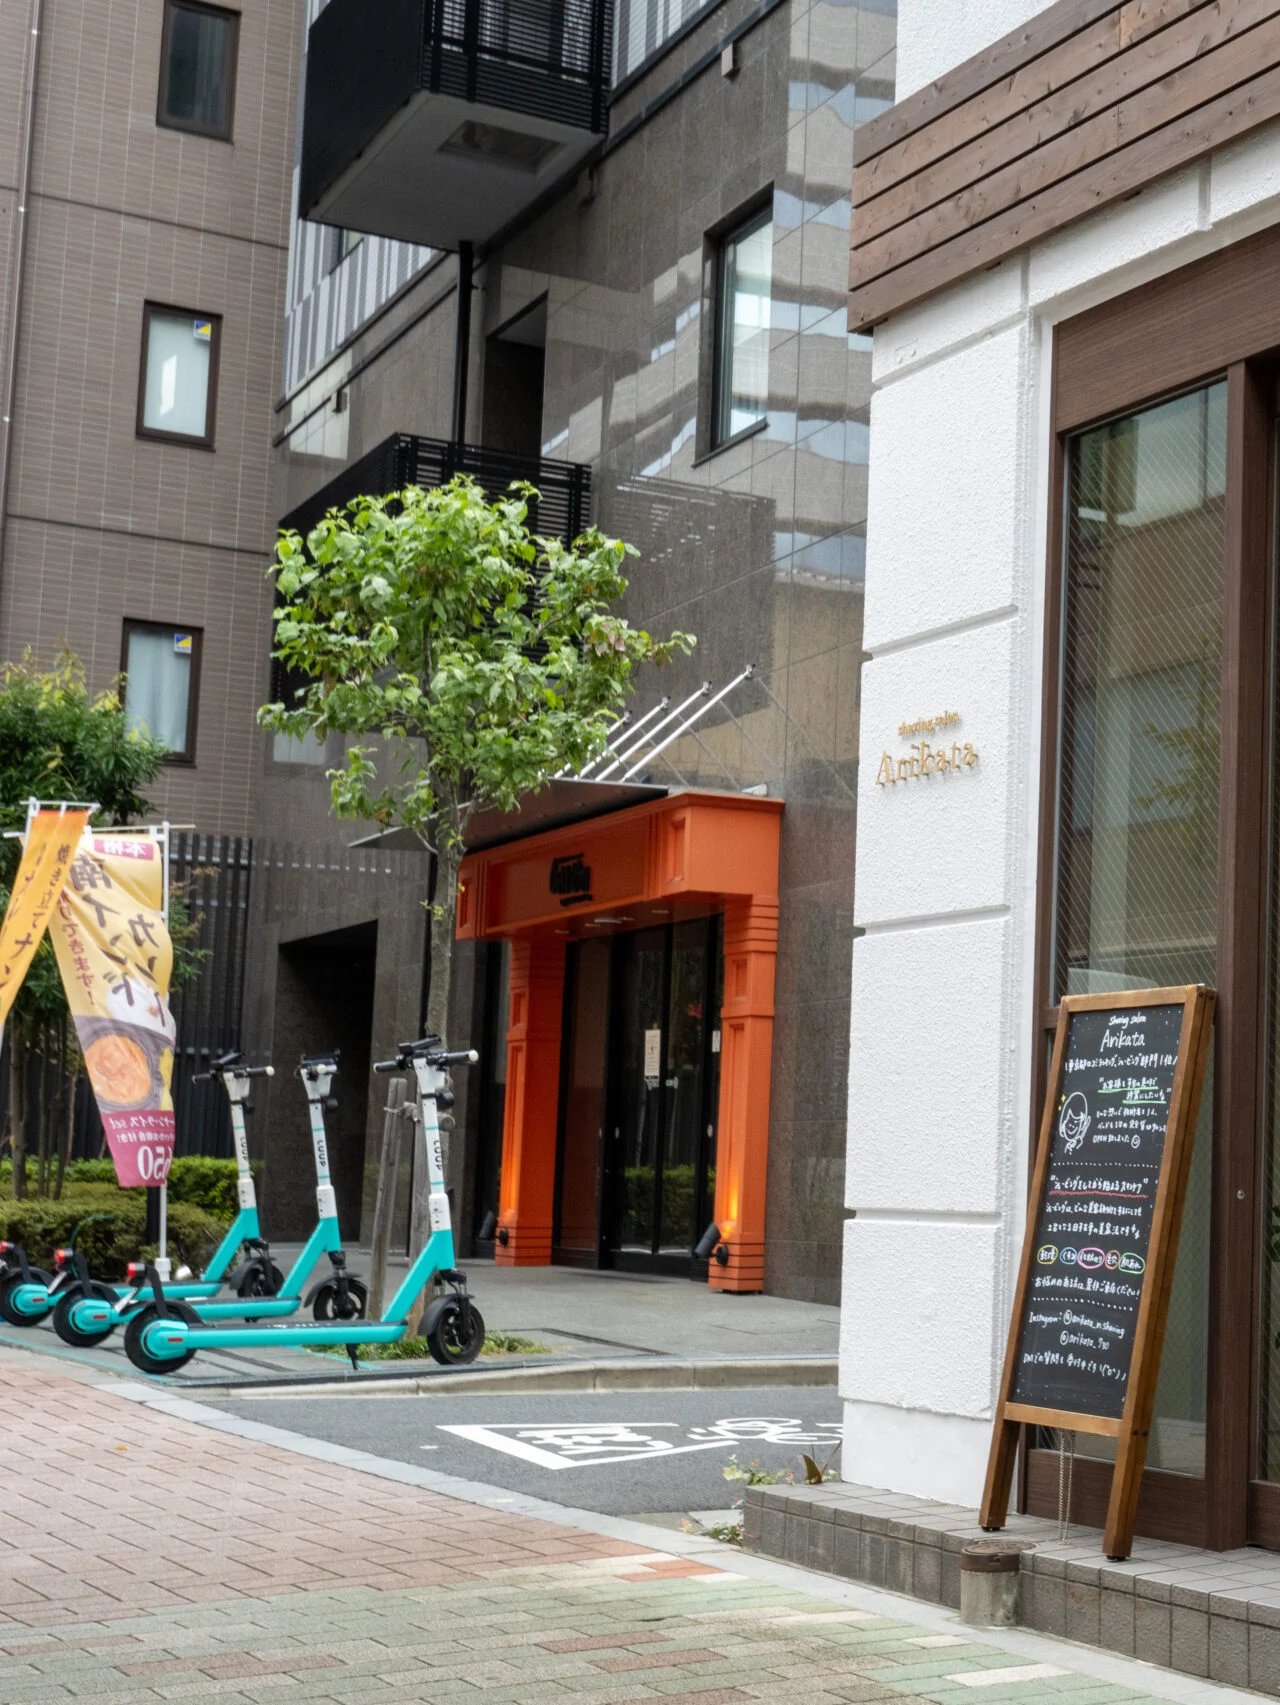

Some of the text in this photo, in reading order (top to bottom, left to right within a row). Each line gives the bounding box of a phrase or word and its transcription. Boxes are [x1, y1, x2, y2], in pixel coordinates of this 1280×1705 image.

[876, 741, 977, 786] Arikata
[1099, 1028, 1146, 1052] Arikata
[317, 1139, 327, 1168] LUUP
[433, 1139, 443, 1171] LUUP
